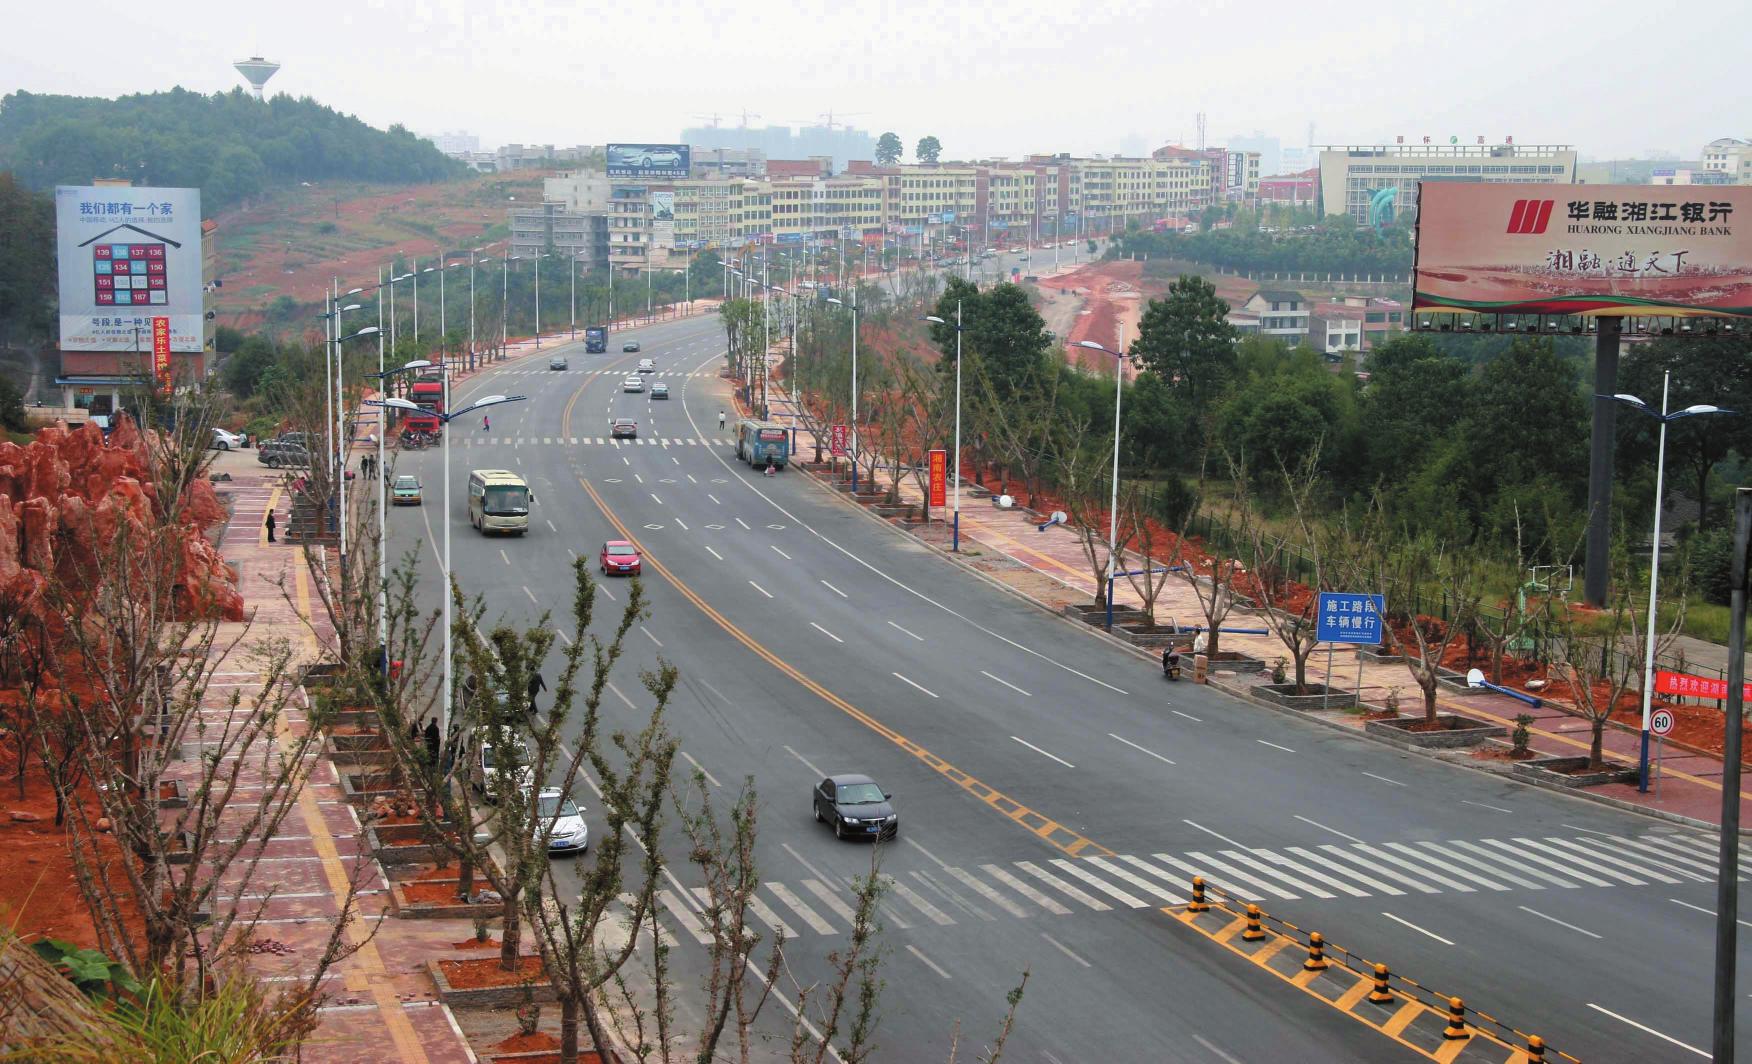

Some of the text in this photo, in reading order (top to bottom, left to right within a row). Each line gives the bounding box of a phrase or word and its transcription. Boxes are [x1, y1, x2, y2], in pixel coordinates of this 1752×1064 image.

[80, 202, 173, 215] 我们都有一个家
[1567, 201, 1733, 223] 华融湘江银行
[1567, 225, 1731, 236] HUARONG XIANGJIANG BANK
[92, 317, 151, 327] 号段,是一种见
[1326, 599, 1375, 613] 施工路段
[1326, 615, 1375, 629] 车辆慢行
[1654, 716, 1668, 728] 60
